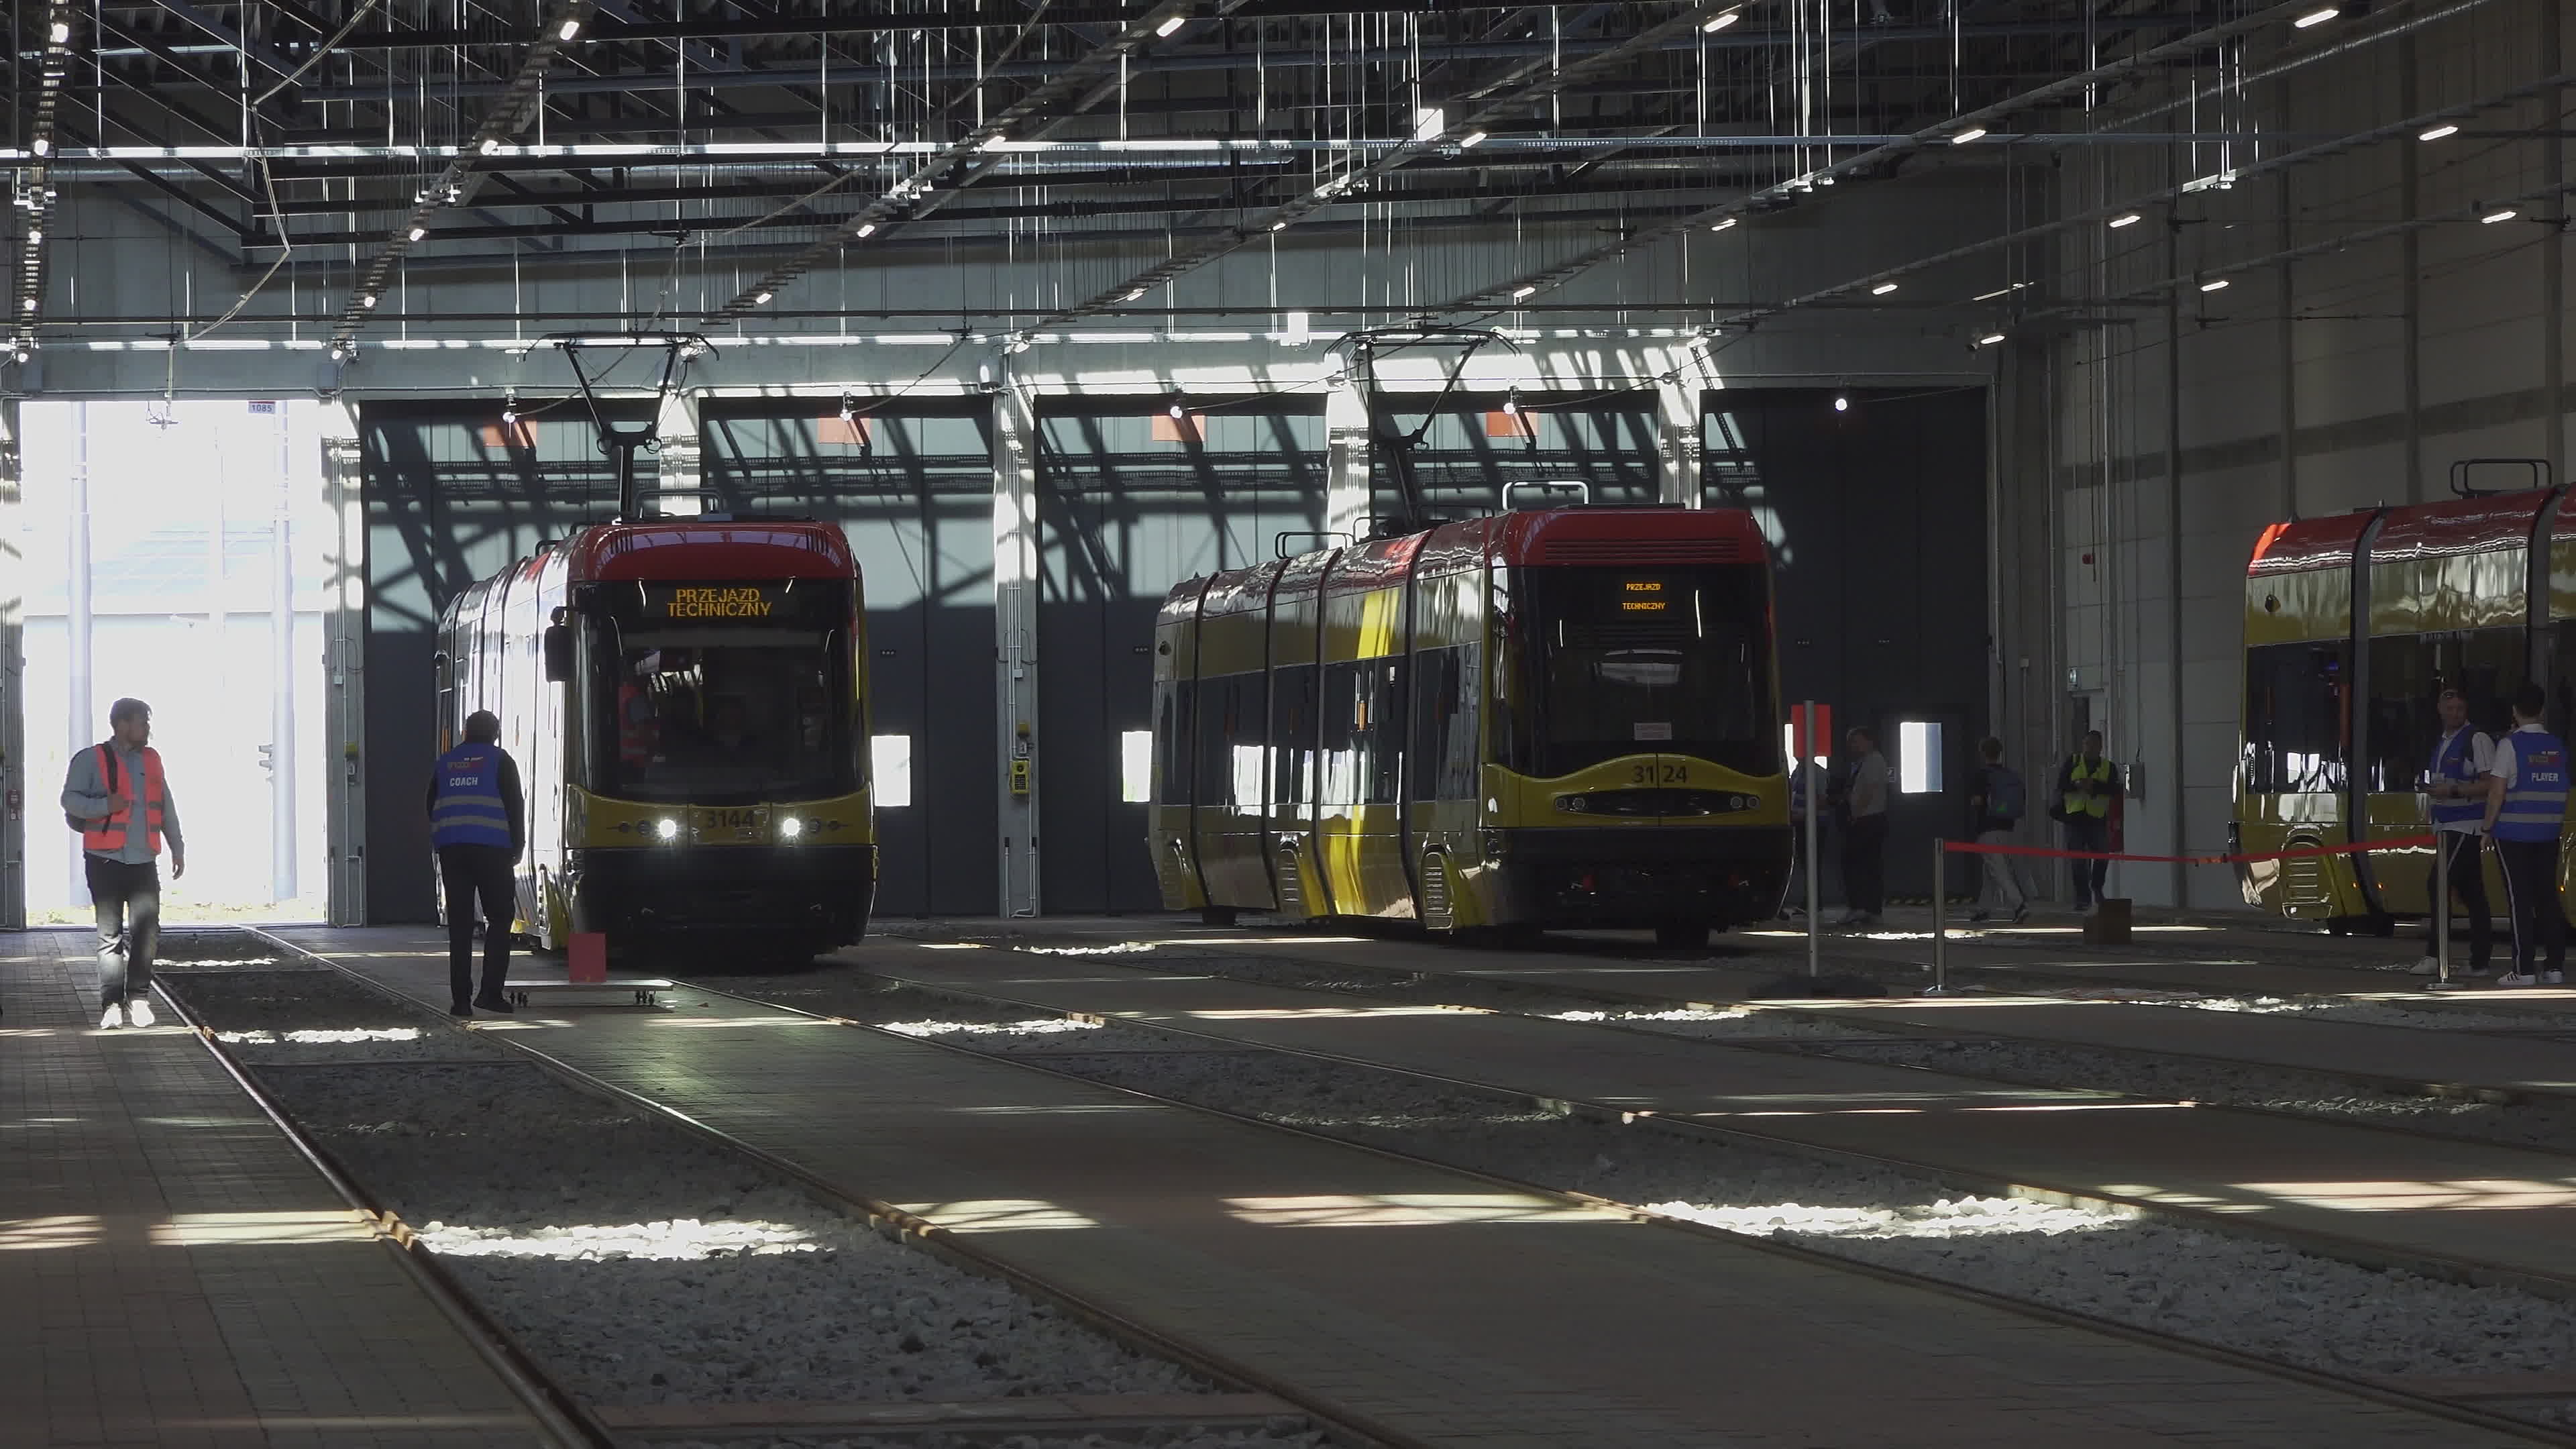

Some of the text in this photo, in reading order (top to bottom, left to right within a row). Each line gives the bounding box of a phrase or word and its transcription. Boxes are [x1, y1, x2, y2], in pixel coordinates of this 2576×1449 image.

[252, 404, 272, 412] 1085
[1625, 583, 1661, 591] PRZEJAZD
[676, 588, 761, 603] PRZEJAZD
[667, 602, 772, 617] TECHNICZNY
[1622, 602, 1665, 610] TECHNICZNY
[449, 776, 478, 787] COACH
[2531, 772, 2559, 783] PLAYER
[706, 810, 753, 827] 3144
